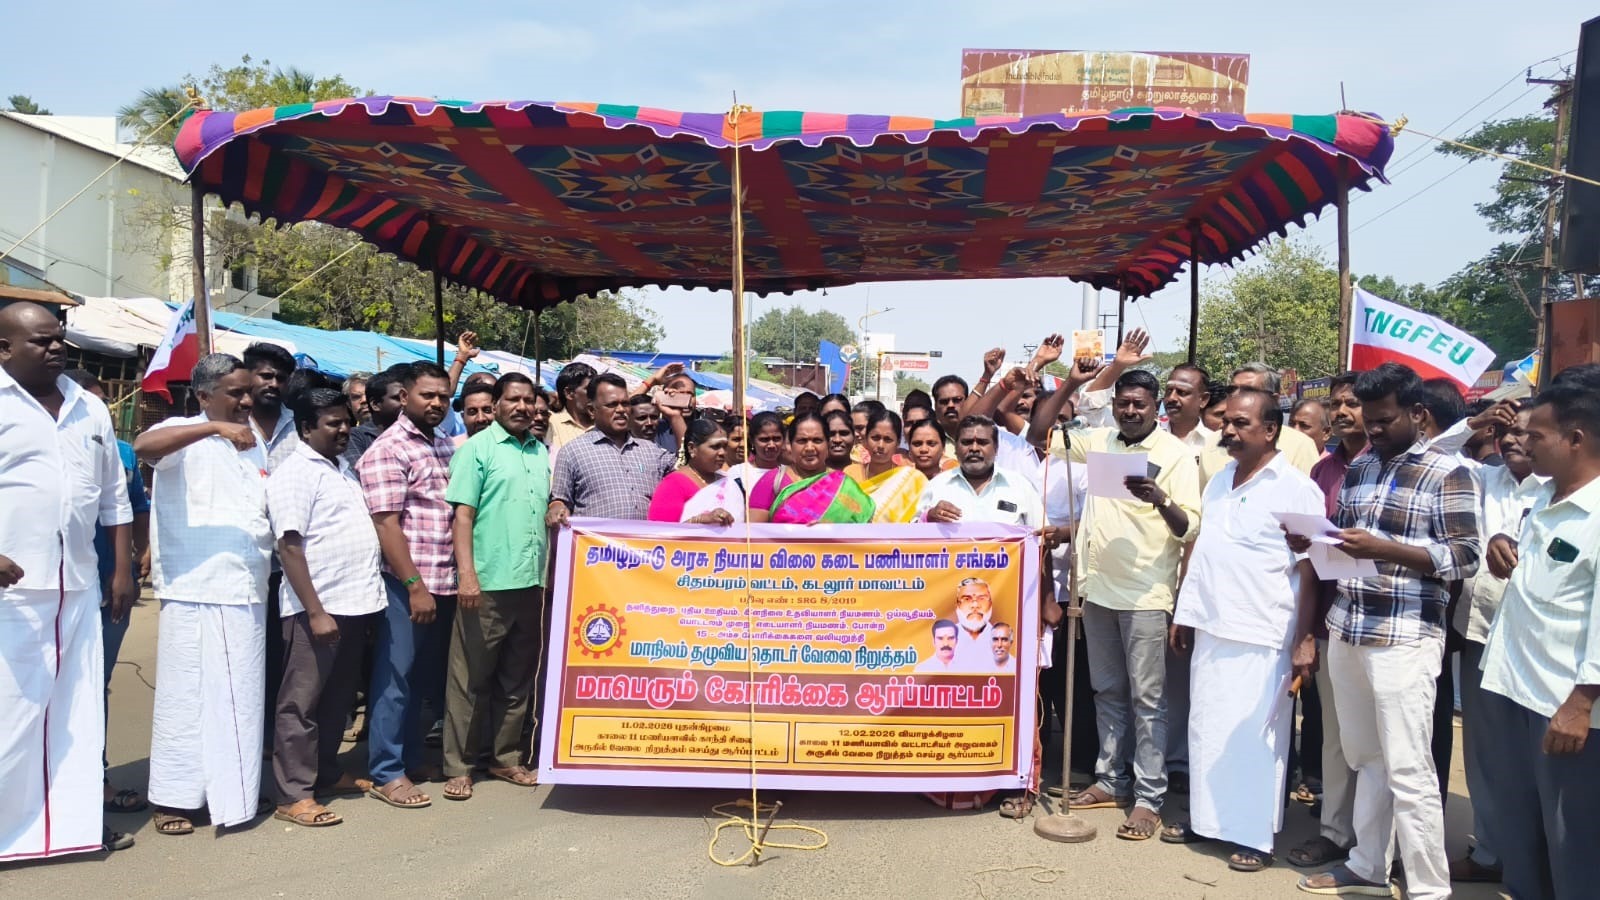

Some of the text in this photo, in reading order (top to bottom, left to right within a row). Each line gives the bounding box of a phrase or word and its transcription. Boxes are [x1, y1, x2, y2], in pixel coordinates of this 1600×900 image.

[1364, 307, 1475, 366] TNGFEU
[671, 550, 709, 571] அரசு
[713, 548, 763, 573] நியாய
[769, 548, 816, 569] விலை
[821, 553, 859, 569] கடை
[865, 548, 949, 569] பணியாளர்
[955, 547, 1009, 569] சங்கம்
[677, 575, 925, 594] சிதம்பரம் வட்டம், கடலூர் மாவட்டம்
[820, 596, 857, 606] 8/2019
[786, 609, 837, 618] உதவியாளர்
[852, 622, 885, 631] போன்ற
[815, 633, 865, 643] வலியுறுத்தி
[630, 639, 917, 669] மாநிலம் தழுவிய தொடர் வேலை நிறுத்தம்
[576, 670, 1003, 715] மாபெரும் கோரிக்கை ஆர்ப்பாட்டம்
[621, 721, 730, 733] 11.02.2026 புதன்கிழமை
[639, 733, 698, 742] மணியளவில்
[700, 734, 727, 744] காந்தி
[729, 735, 753, 744] சிலை
[839, 729, 964, 739] 12.02.2026 வியாழக்கிழமை
[843, 739, 898, 747] மணியளவில்
[901, 740, 952, 748] வட்டாட்சியர்
[574, 743, 779, 756] அருகில் வேலை நிறுத்தம் செய்து ஆர்ப்பாட்டம்
[806, 749, 840, 758] அருகில்
[876, 750, 914, 760] நிறுத்தம்
[916, 750, 945, 760] செய்து
[947, 750, 995, 760] ஆர்ப்பாட்டம்
